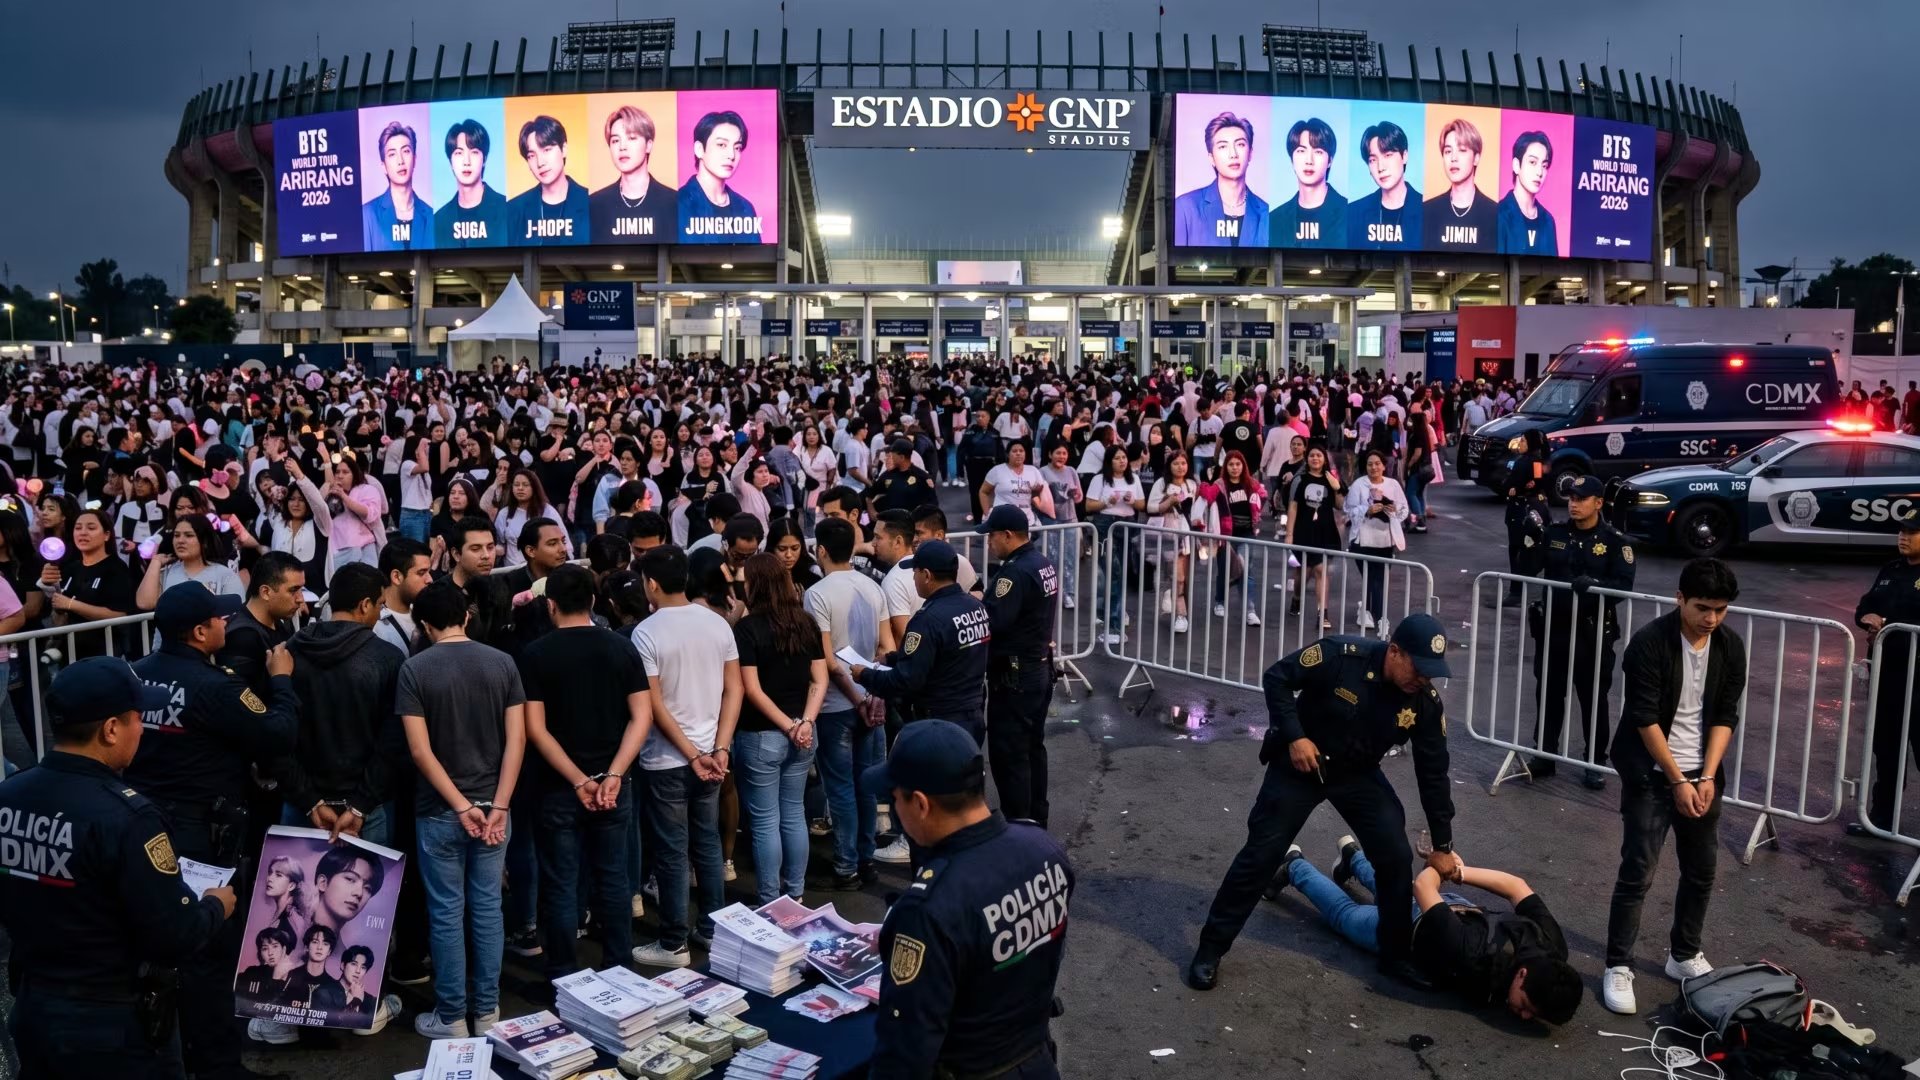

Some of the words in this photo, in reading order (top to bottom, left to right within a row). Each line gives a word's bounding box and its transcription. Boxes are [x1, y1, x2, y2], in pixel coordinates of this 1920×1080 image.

[831, 95, 1002, 128] ESTADIO
[1048, 97, 1131, 129] GNP
[298, 128, 328, 155] BTS
[1602, 134, 1631, 160] BTS
[292, 157, 317, 169] WORLD
[318, 154, 338, 167] TOUR
[1593, 159, 1618, 172] WORLD
[1619, 162, 1638, 174] TOUR
[280, 166, 354, 191] ARIRANG
[1578, 172, 1649, 196] ARIRANG
[301, 190, 331, 206] 2026
[1600, 195, 1629, 211] 2026
[392, 224, 410, 241] RM
[453, 221, 487, 239] SUGA
[525, 218, 573, 239] J-HOPE
[612, 217, 654, 236] JIMIN
[685, 216, 763, 235] JUNGKOOK
[1216, 220, 1239, 238] RM
[1296, 222, 1320, 240] JIN
[1367, 223, 1403, 242] SUGA
[1441, 225, 1478, 244] JIMIN
[1527, 229, 1537, 247] V
[587, 290, 620, 303] GNP
[1745, 383, 1822, 404] CDMX
[1679, 440, 1710, 456] SSC
[1850, 498, 1913, 522] SSC
[0, 807, 73, 849] OLICÍA
[1, 837, 74, 879] DMX
[982, 860, 1068, 934] POLICÍA
[992, 888, 1068, 962] CDMX
[308, 1009, 328, 1019] TOUR
